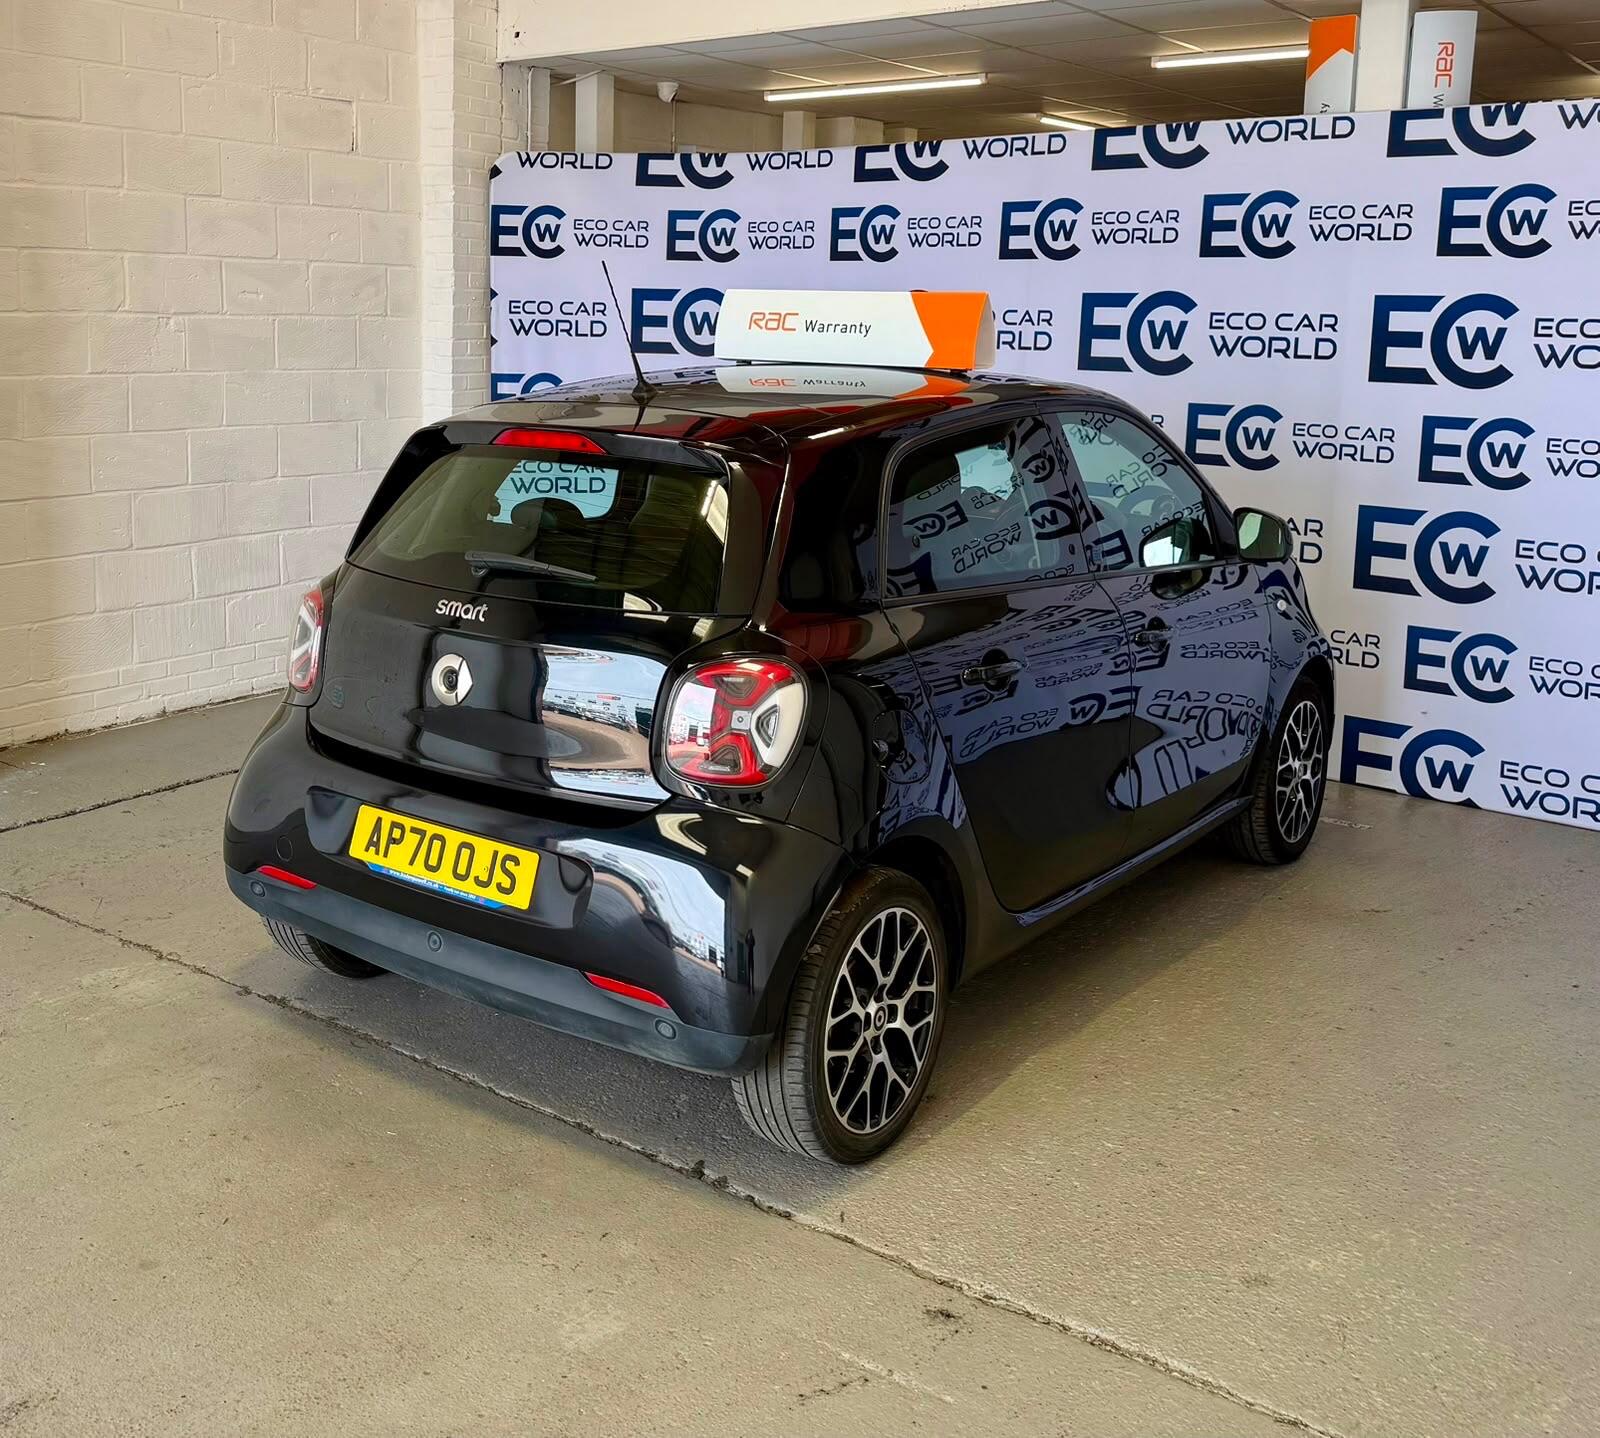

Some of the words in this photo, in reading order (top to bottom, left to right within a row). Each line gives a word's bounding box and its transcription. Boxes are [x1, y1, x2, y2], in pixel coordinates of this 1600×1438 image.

[1225, 115, 1355, 145] WORLD
[962, 133, 1067, 160] WORLD
[516, 151, 614, 170] WORLD
[746, 150, 834, 172] WORLD
[1091, 210, 1131, 225] ECO
[1136, 209, 1180, 224] CAR
[1309, 204, 1356, 221] ECO
[1361, 202, 1414, 219] CAR
[573, 218, 608, 231] ECO
[612, 219, 649, 232] CAR
[747, 221, 779, 233] ECO
[782, 220, 815, 233] CAR
[907, 217, 942, 230] ECO
[945, 215, 982, 229] CAR
[1309, 222, 1413, 242] WORLD
[573, 232, 649, 248] WORLD
[748, 235, 815, 250] WORLD
[907, 231, 982, 248] WORLD
[1091, 226, 1180, 246] WORLD
[508, 300, 553, 315] ECO
[559, 301, 607, 317] CAR
[1002, 309, 1053, 327] CAR
[509, 318, 607, 338] WORLD
[804, 318, 872, 338] Warranty
[1208, 311, 1267, 331] ECO
[1274, 312, 1339, 333] CAR
[996, 330, 1053, 352] RLD
[1208, 335, 1338, 360] WORLD
[1292, 422, 1338, 439] ECO
[1344, 425, 1396, 443] CAR
[1292, 440, 1395, 464] WORLD
[1546, 437, 1600, 456] ECO
[510, 476, 606, 494] WORLD
[1287, 517, 1324, 538] AR
[1515, 539, 1587, 564] ECO
[435, 599, 488, 622] smart
[1330, 629, 1381, 648] CAR
[1331, 646, 1380, 668] RLD
[1529, 656, 1583, 676] ECO
[1500, 760, 1570, 789] ECO
[364, 816, 447, 874] AP70
[452, 840, 521, 896] OJS
